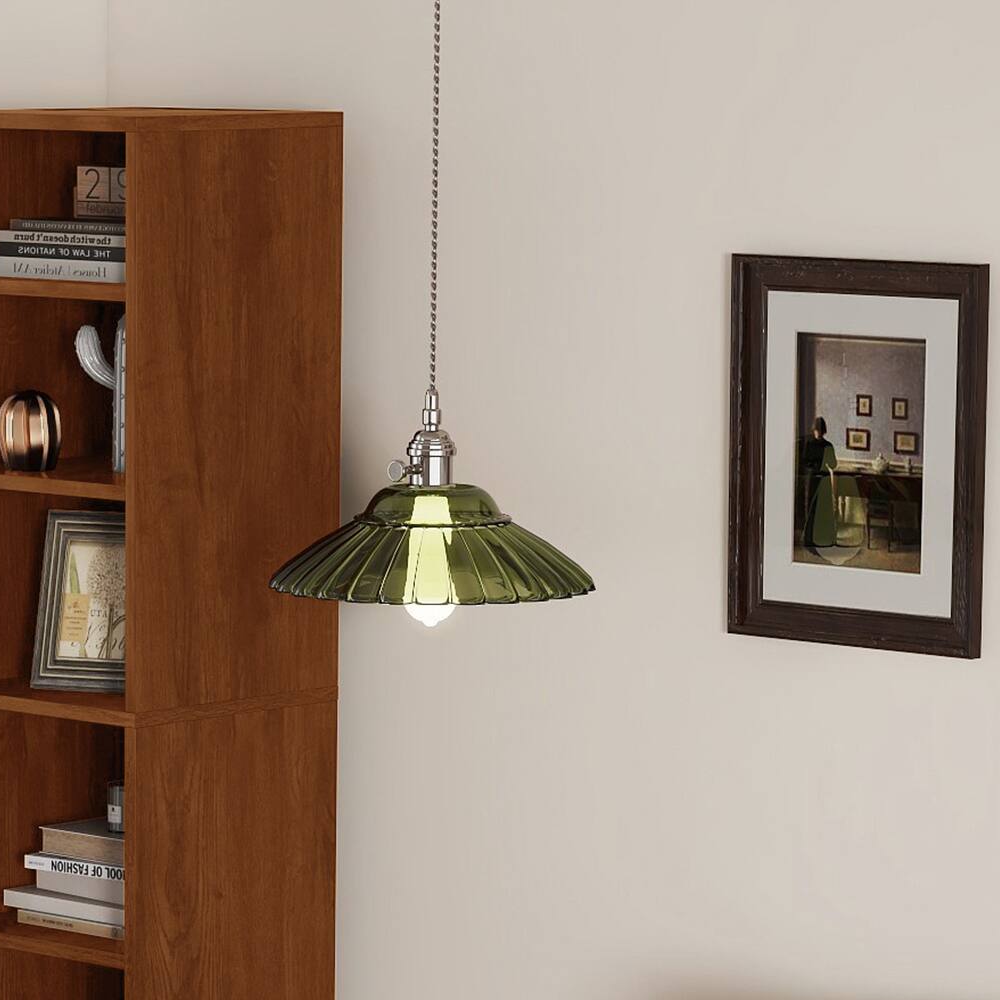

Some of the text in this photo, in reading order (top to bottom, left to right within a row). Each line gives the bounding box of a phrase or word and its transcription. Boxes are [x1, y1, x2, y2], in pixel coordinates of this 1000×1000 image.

[50, 860, 89, 876] FASHION
[90, 865, 103, 878] OF
[105, 867, 125, 880] OOL
